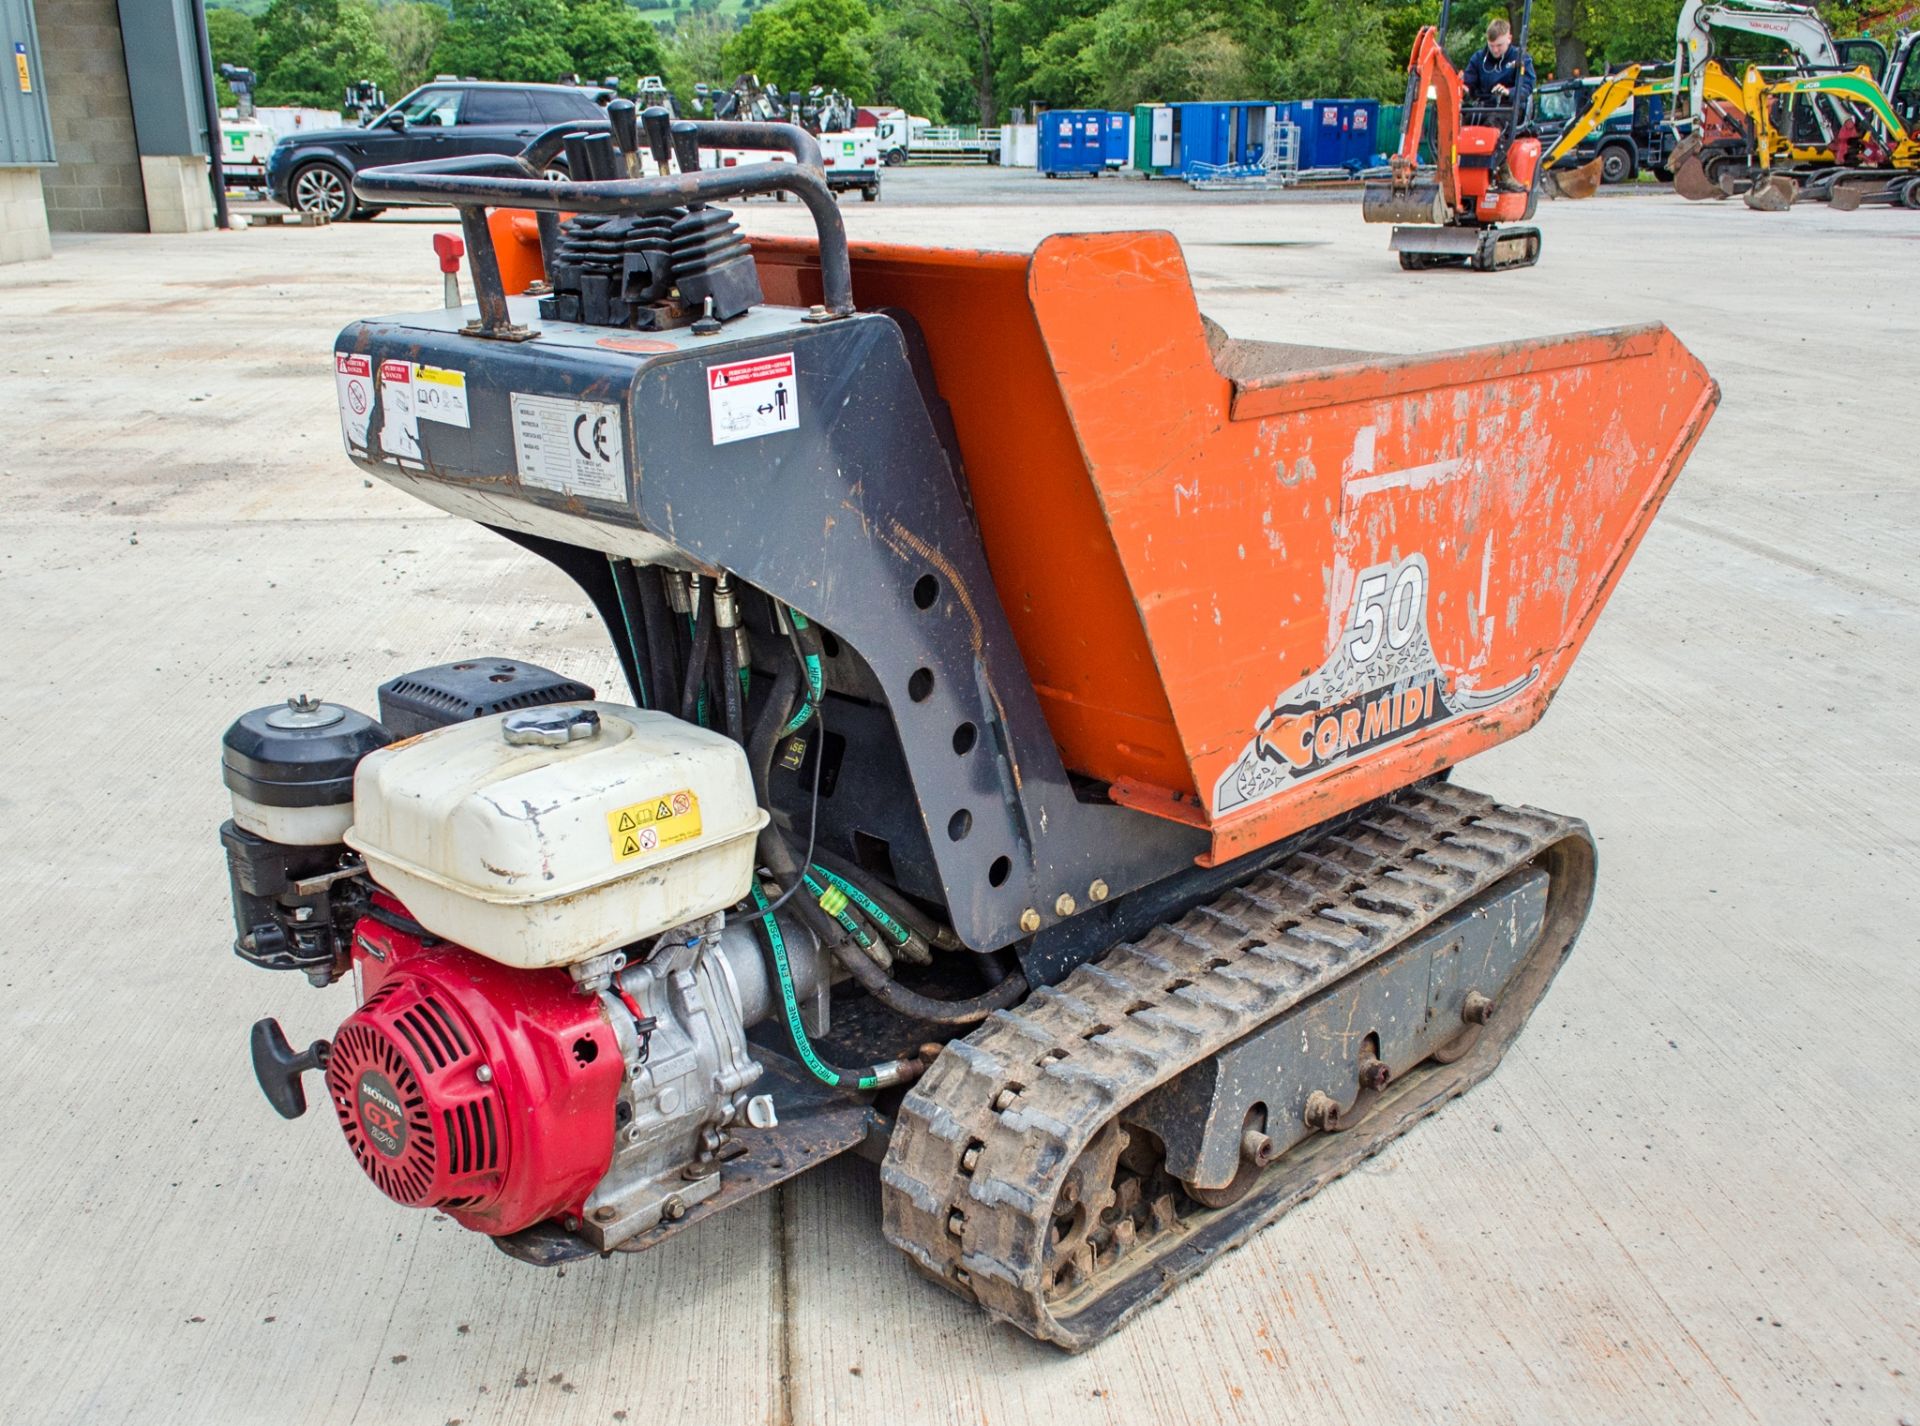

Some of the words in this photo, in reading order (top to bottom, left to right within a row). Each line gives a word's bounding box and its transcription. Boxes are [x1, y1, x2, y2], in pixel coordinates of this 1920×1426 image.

[1803, 81, 1821, 90] JCB
[1348, 563, 1425, 663] 50
[1284, 680, 1435, 767] CORMIDI
[831, 877, 848, 892] 853
[851, 889, 871, 908] 2SN
[873, 908, 883, 919] 10
[769, 918, 781, 940] 2SN
[777, 942, 787, 962] 853
[781, 963, 791, 978] EN
[785, 982, 795, 1002] 222
[788, 1004, 811, 1057] GREENLINE
[810, 1057, 832, 1081] HIFLEX
[362, 1083, 403, 1117] HONDA
[363, 1101, 401, 1139] GX
